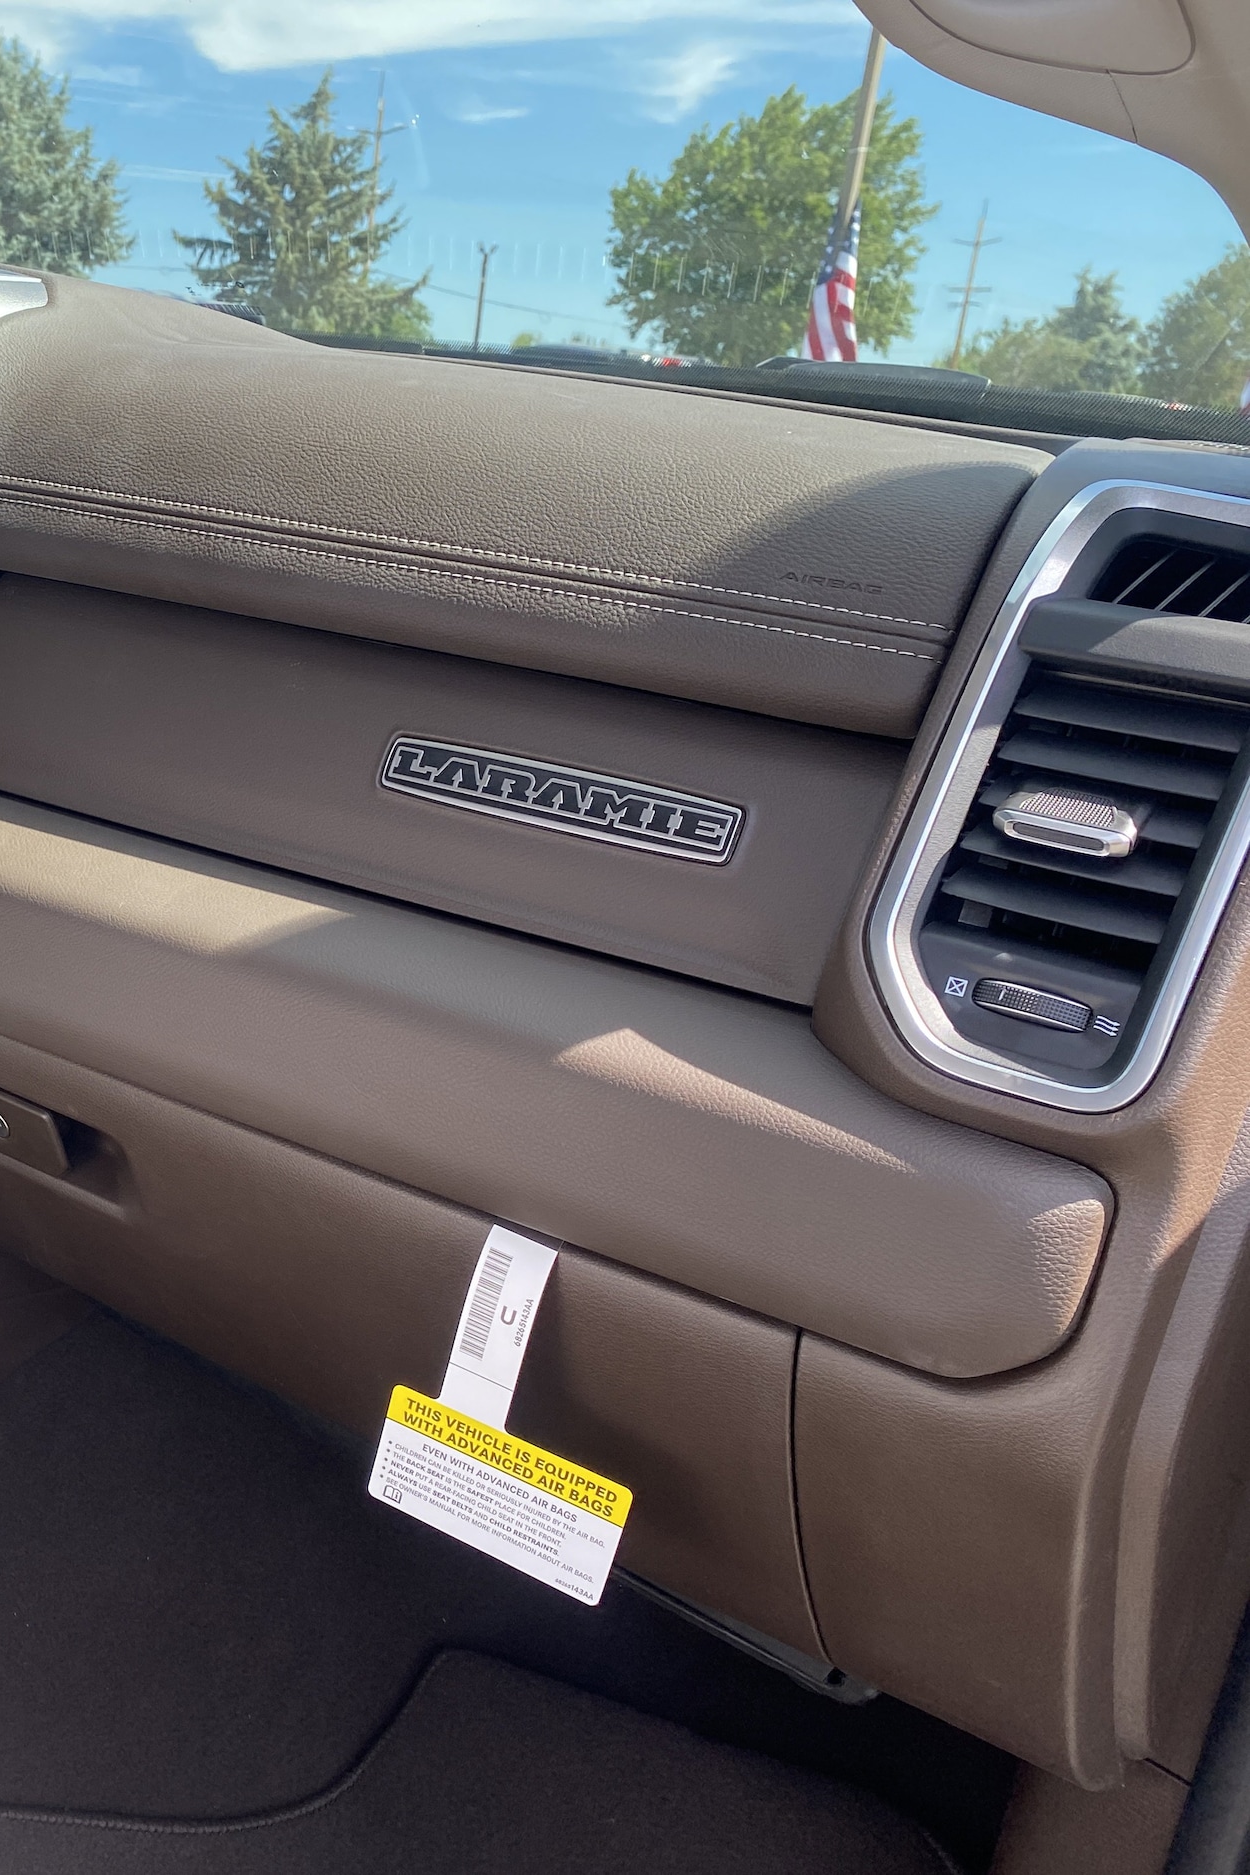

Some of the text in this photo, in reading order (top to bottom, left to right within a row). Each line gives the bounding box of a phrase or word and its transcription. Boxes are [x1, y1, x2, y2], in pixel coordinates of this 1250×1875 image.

[779, 571, 883, 595] AIRBAG
[388, 745, 734, 851] LARAMIE
[500, 1305, 517, 1326] U
[513, 1298, 535, 1348] 68265143AA
[392, 1450, 567, 1540] THE BACK SEAT IS THE SAFEST PLACE FOR CHILDREN.
[394, 1442, 427, 1463] CHILDREN
[426, 1457, 441, 1470] CAN
[441, 1465, 451, 1475] BE
[451, 1469, 475, 1486] KILLED
[474, 1480, 486, 1491] OR
[485, 1486, 522, 1509] SERIOUSLY
[522, 1503, 551, 1522] INJURED
[551, 1517, 561, 1527] BY
[561, 1522, 576, 1534] THE
[575, 1529, 589, 1540] AIR
[402, 1410, 614, 1518] WITH ADVANCED AIR BAGS
[405, 1397, 619, 1504] THIS VEHICLE IS EQUIPPED
[421, 1442, 578, 1523] EVEN WITH ADVANCED AIR BAGS
[385, 1475, 595, 1584] SEE OWNER'S MANUAL FOR MORE INFORMATION ABOUT AIR BAGS.
[387, 1467, 560, 1557] ALWAYS USE SEAT BELTS AND CHILD RESTRAINTS.
[389, 1459, 563, 1548] NEVER PUT A REAR-FACING CHILD SEAT IN THE FRONT.
